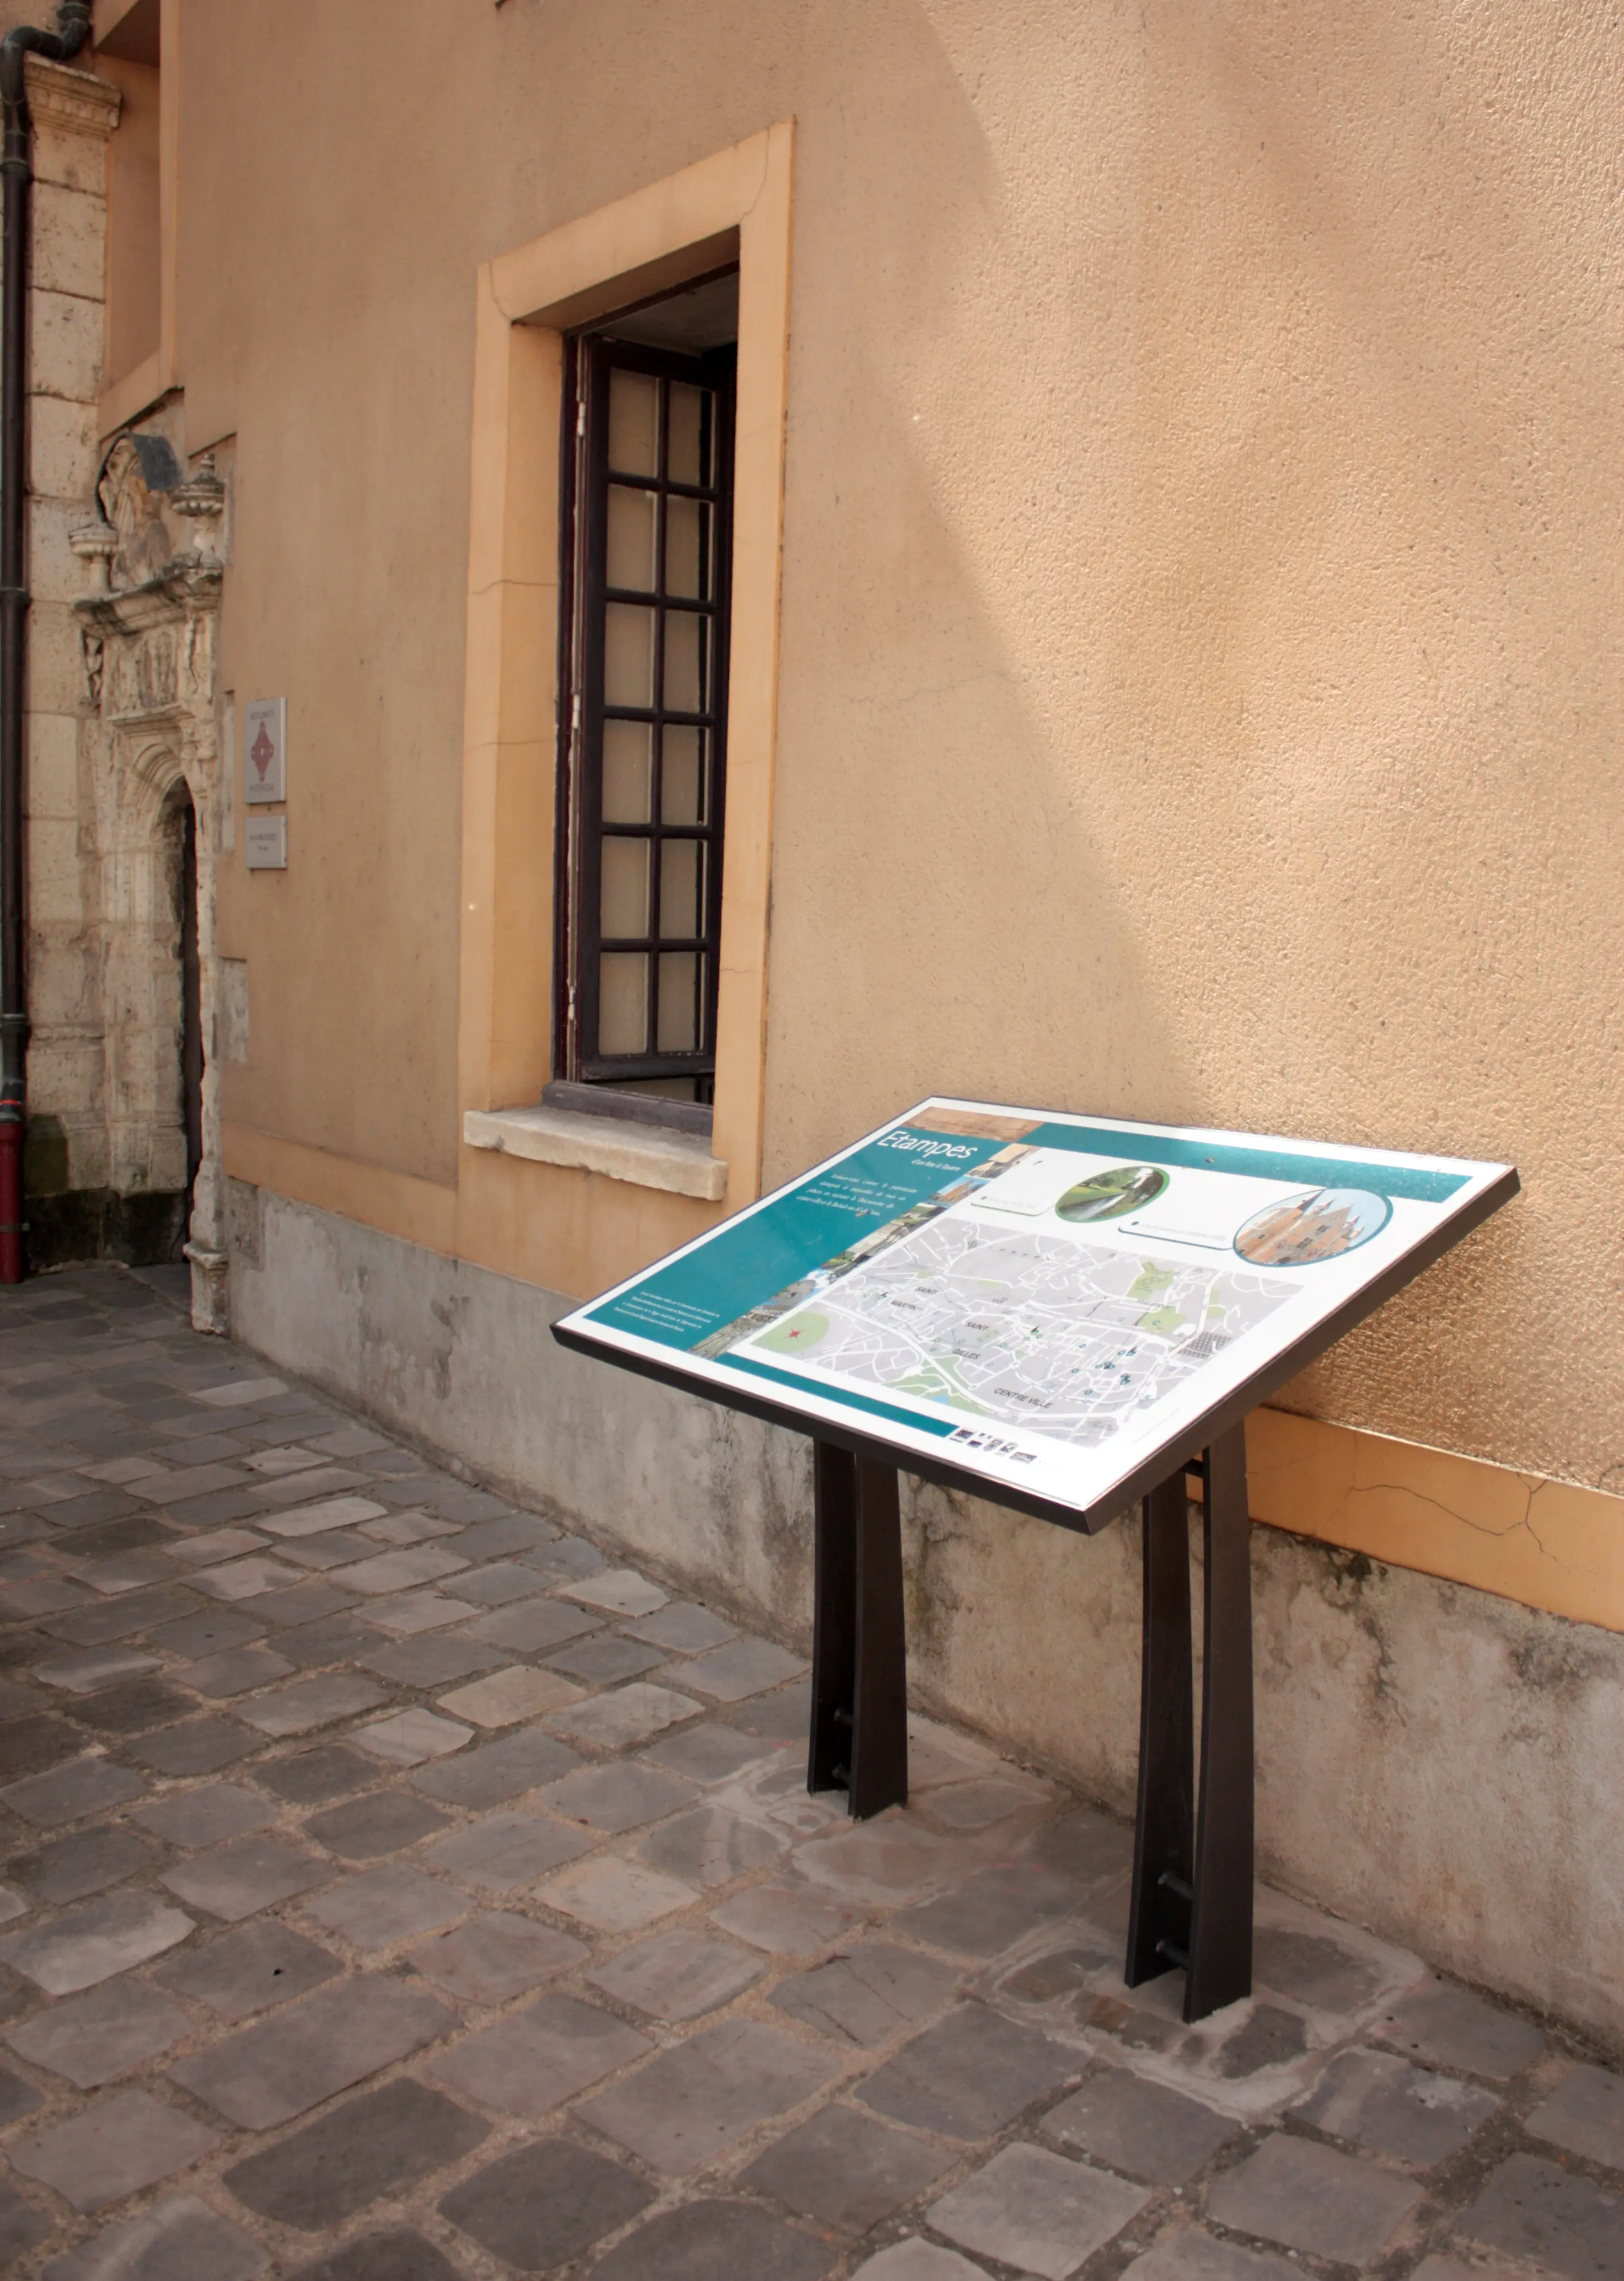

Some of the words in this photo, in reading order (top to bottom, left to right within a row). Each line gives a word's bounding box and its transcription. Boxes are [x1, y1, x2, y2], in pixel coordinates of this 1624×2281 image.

[877, 1131, 978, 1158] Etampes
[952, 1349, 980, 1359] GILLES
[994, 1388, 1028, 1401] CENTRE
[1028, 1398, 1053, 1409] VILLE
